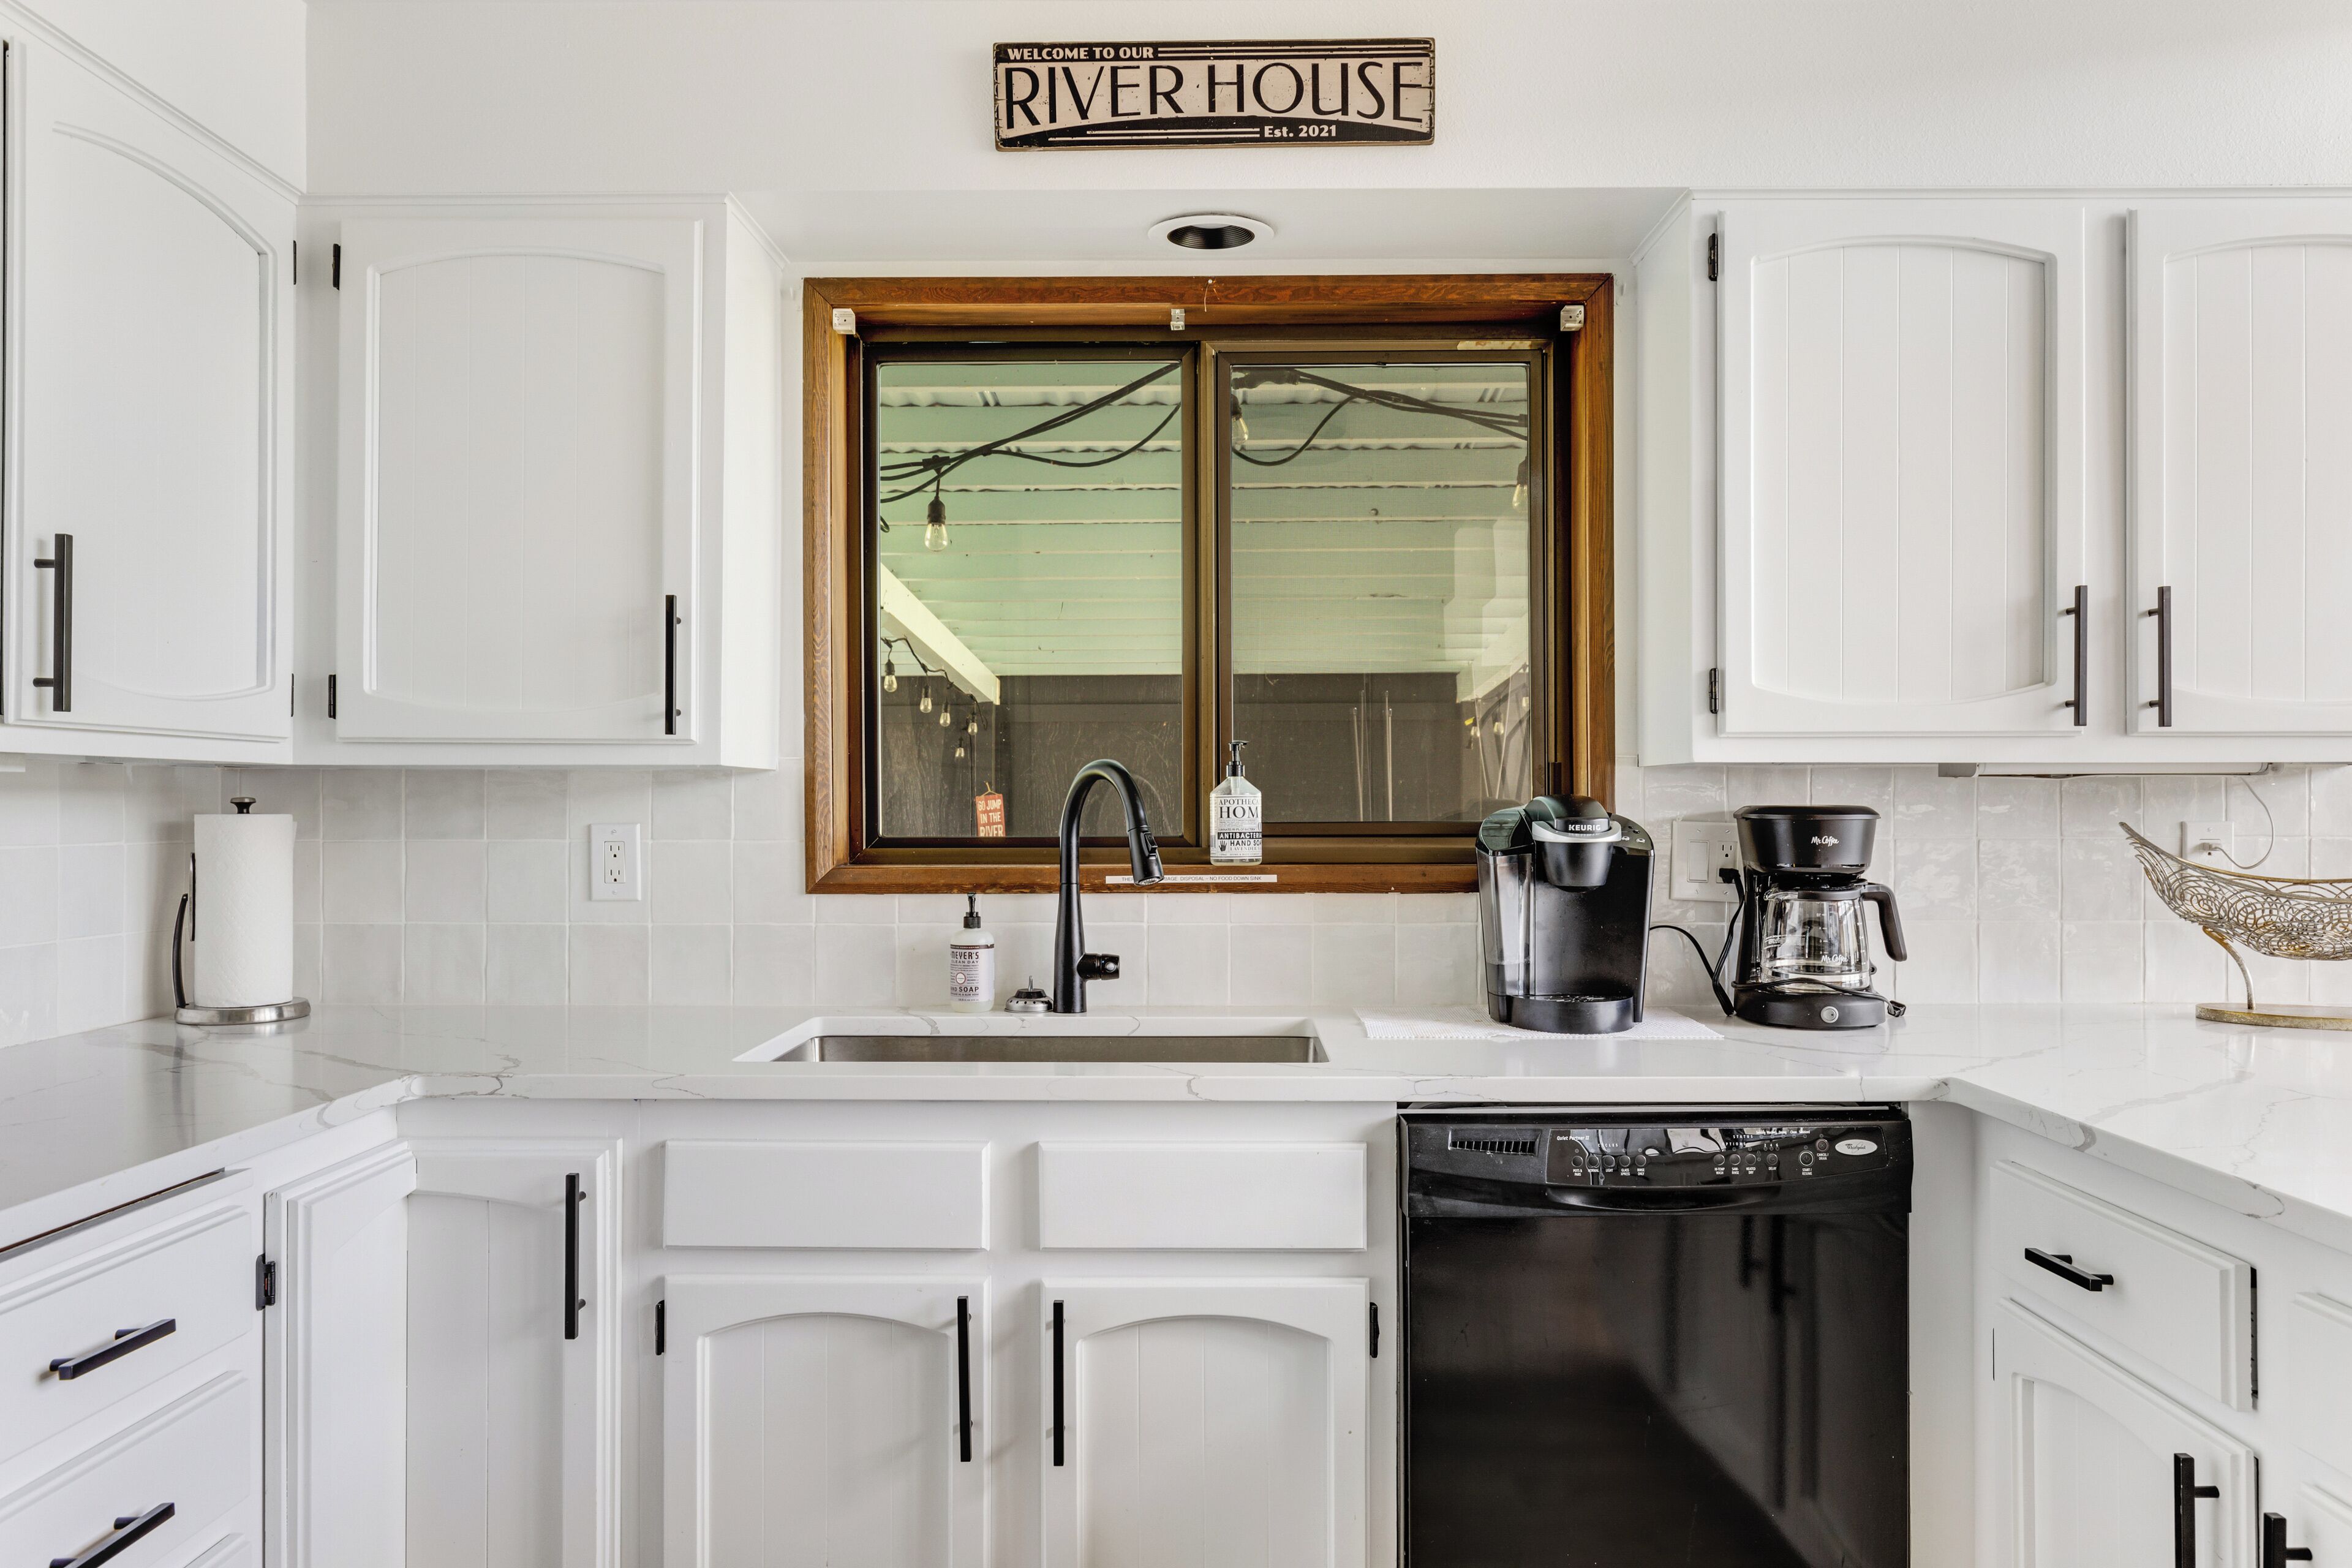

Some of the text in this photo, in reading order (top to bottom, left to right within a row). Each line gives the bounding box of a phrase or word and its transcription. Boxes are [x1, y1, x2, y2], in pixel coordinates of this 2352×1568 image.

[1007, 47, 1154, 59] WELCOME TO OUR
[1005, 61, 1423, 129] RIVER HOUSE
[1264, 125, 1336, 137] Est. 2021
[978, 799, 1001, 811] GO JUMP
[980, 812, 1001, 824] IN THE
[1822, 835, 1839, 847] Coffee
[1831, 954, 1849, 965] Coffee
